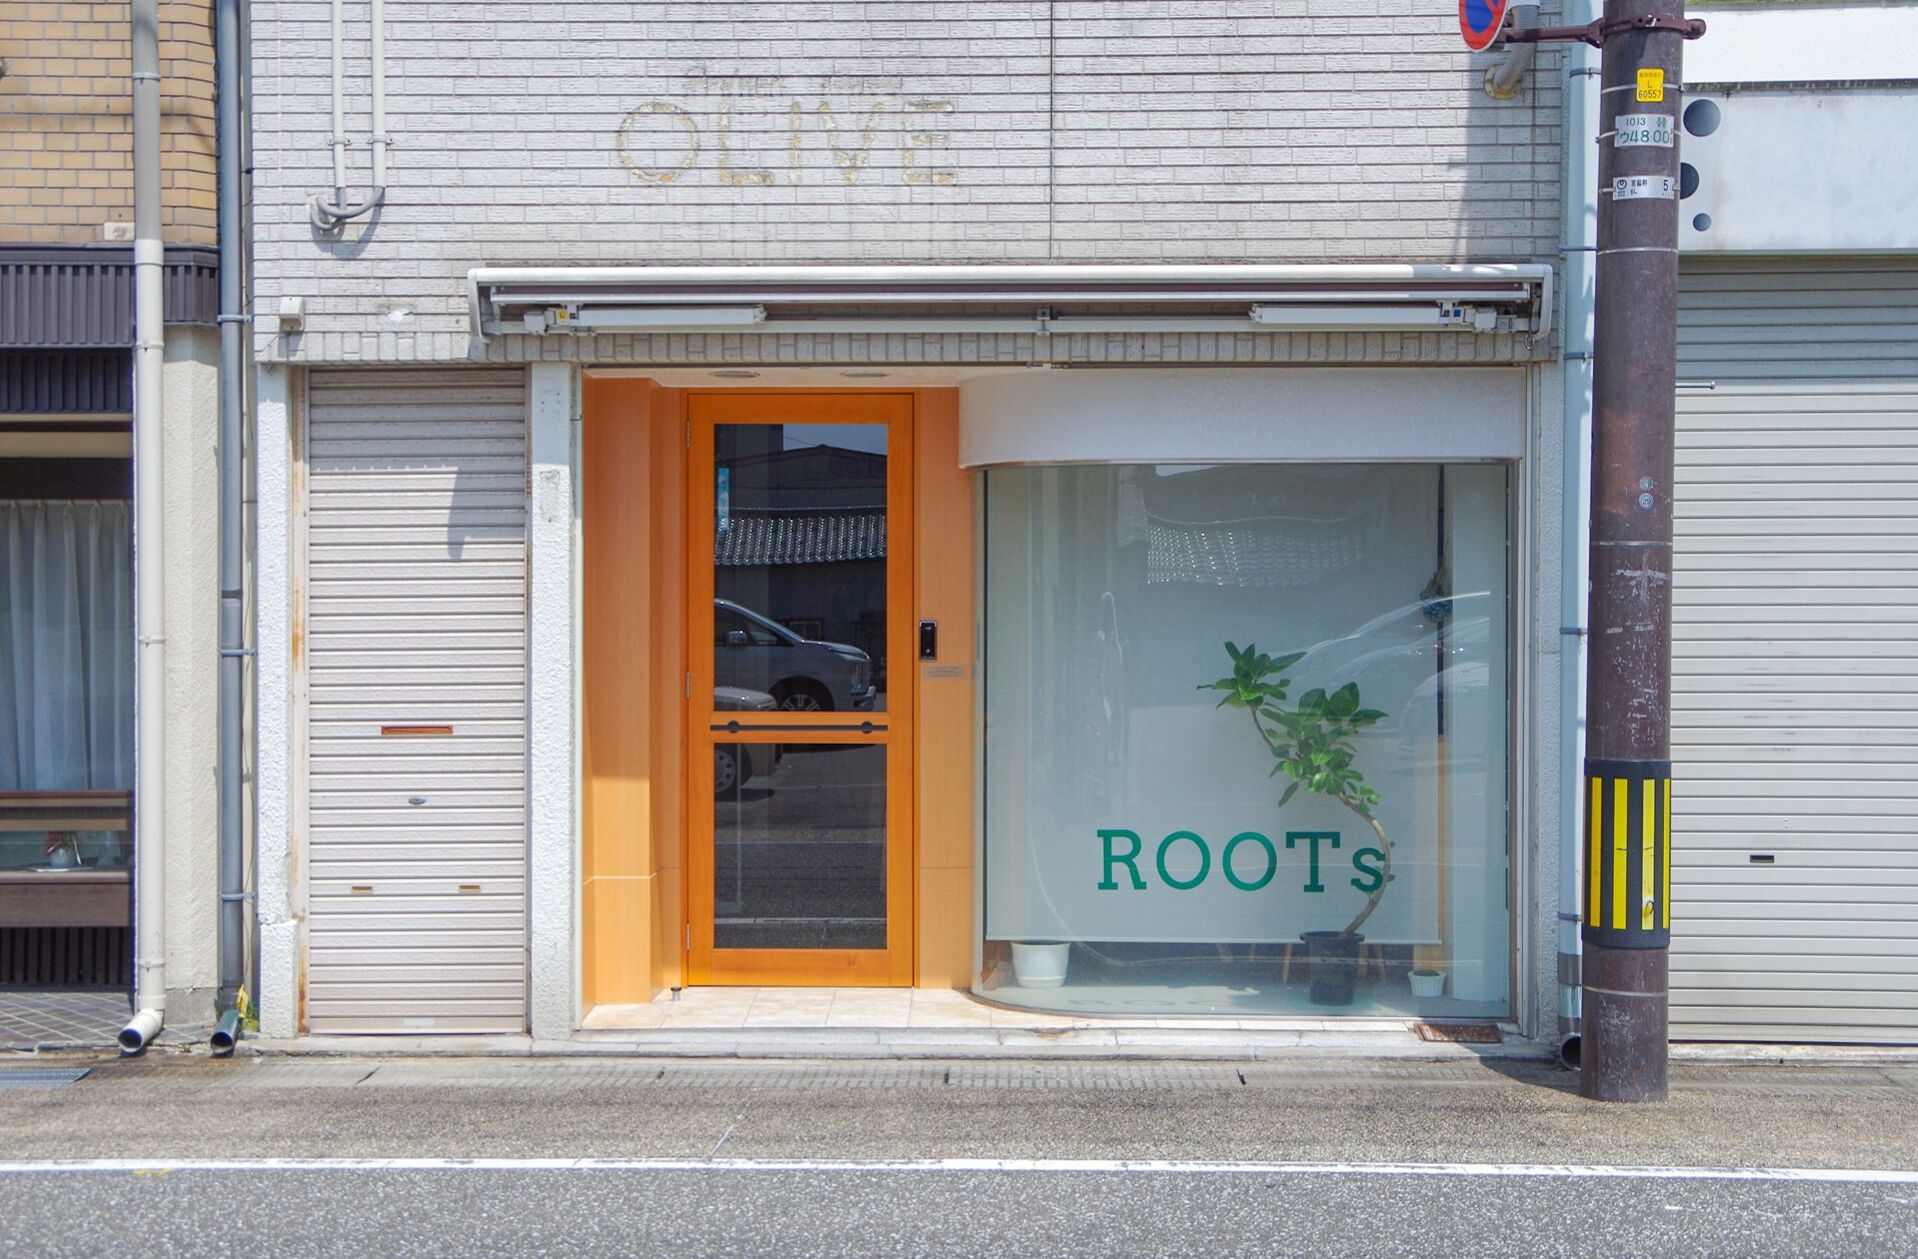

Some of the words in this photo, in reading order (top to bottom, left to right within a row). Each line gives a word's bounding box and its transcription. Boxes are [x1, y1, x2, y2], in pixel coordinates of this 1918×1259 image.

[1648, 79, 1653, 88] L
[1638, 89, 1662, 99] 60557
[1626, 117, 1646, 126] 1013
[618, 101, 956, 185] OLIVE
[1663, 179, 1669, 192] 5
[1097, 829, 1386, 893] ROOTs
